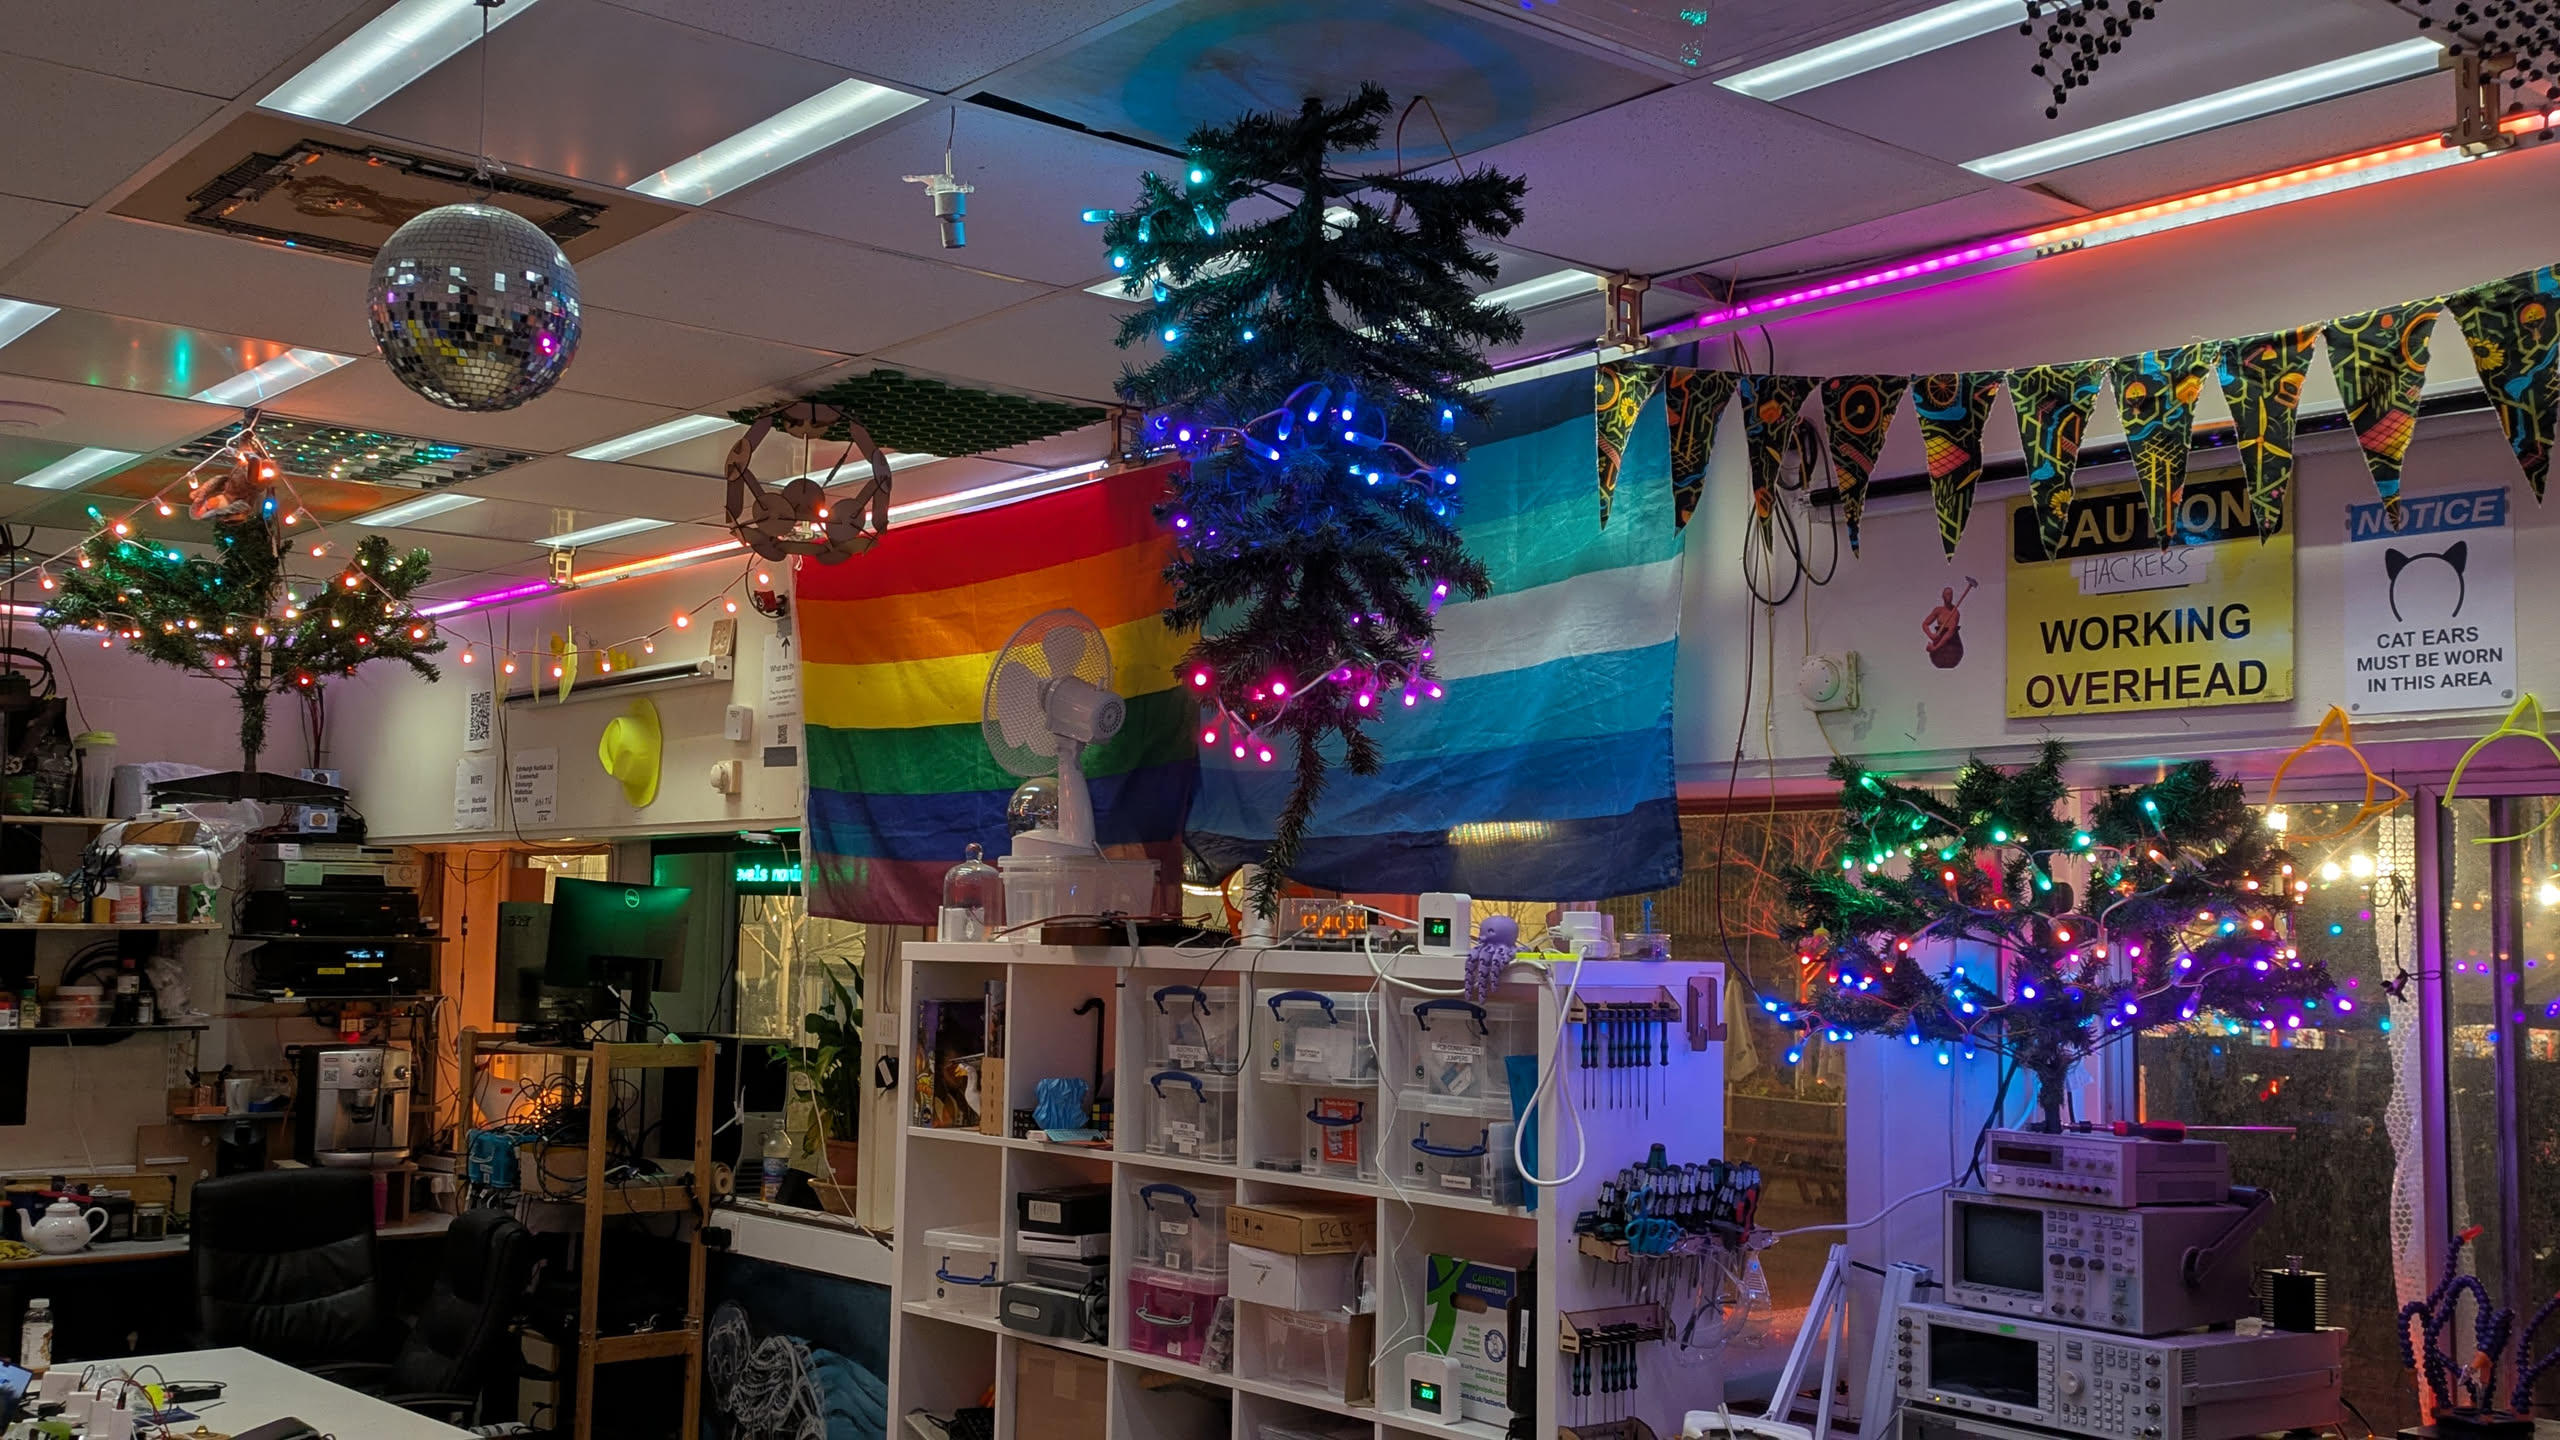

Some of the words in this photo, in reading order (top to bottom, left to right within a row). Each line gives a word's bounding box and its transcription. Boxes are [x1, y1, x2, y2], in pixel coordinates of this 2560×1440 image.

[2357, 496, 2498, 535] NOTICE
[2083, 548, 2195, 590] HACKERS
[2040, 603, 2251, 655] WORKING
[2377, 632, 2415, 649] CAT
[2422, 626, 2479, 646] EARS
[2356, 654, 2410, 672] MUST
[2415, 652, 2439, 668] BE
[2444, 648, 2503, 665] WORN
[2026, 659, 2268, 709] OVERHEAD
[2367, 678, 2387, 693] IN
[2391, 674, 2435, 691] THIS
[2440, 671, 2492, 688] AREA
[1318, 1221, 1353, 1242] PCB
[1465, 1282, 1482, 1292] HEAVY
[1482, 1285, 1507, 1296] CONTENTS
[1471, 1273, 1507, 1289] CAUTION
